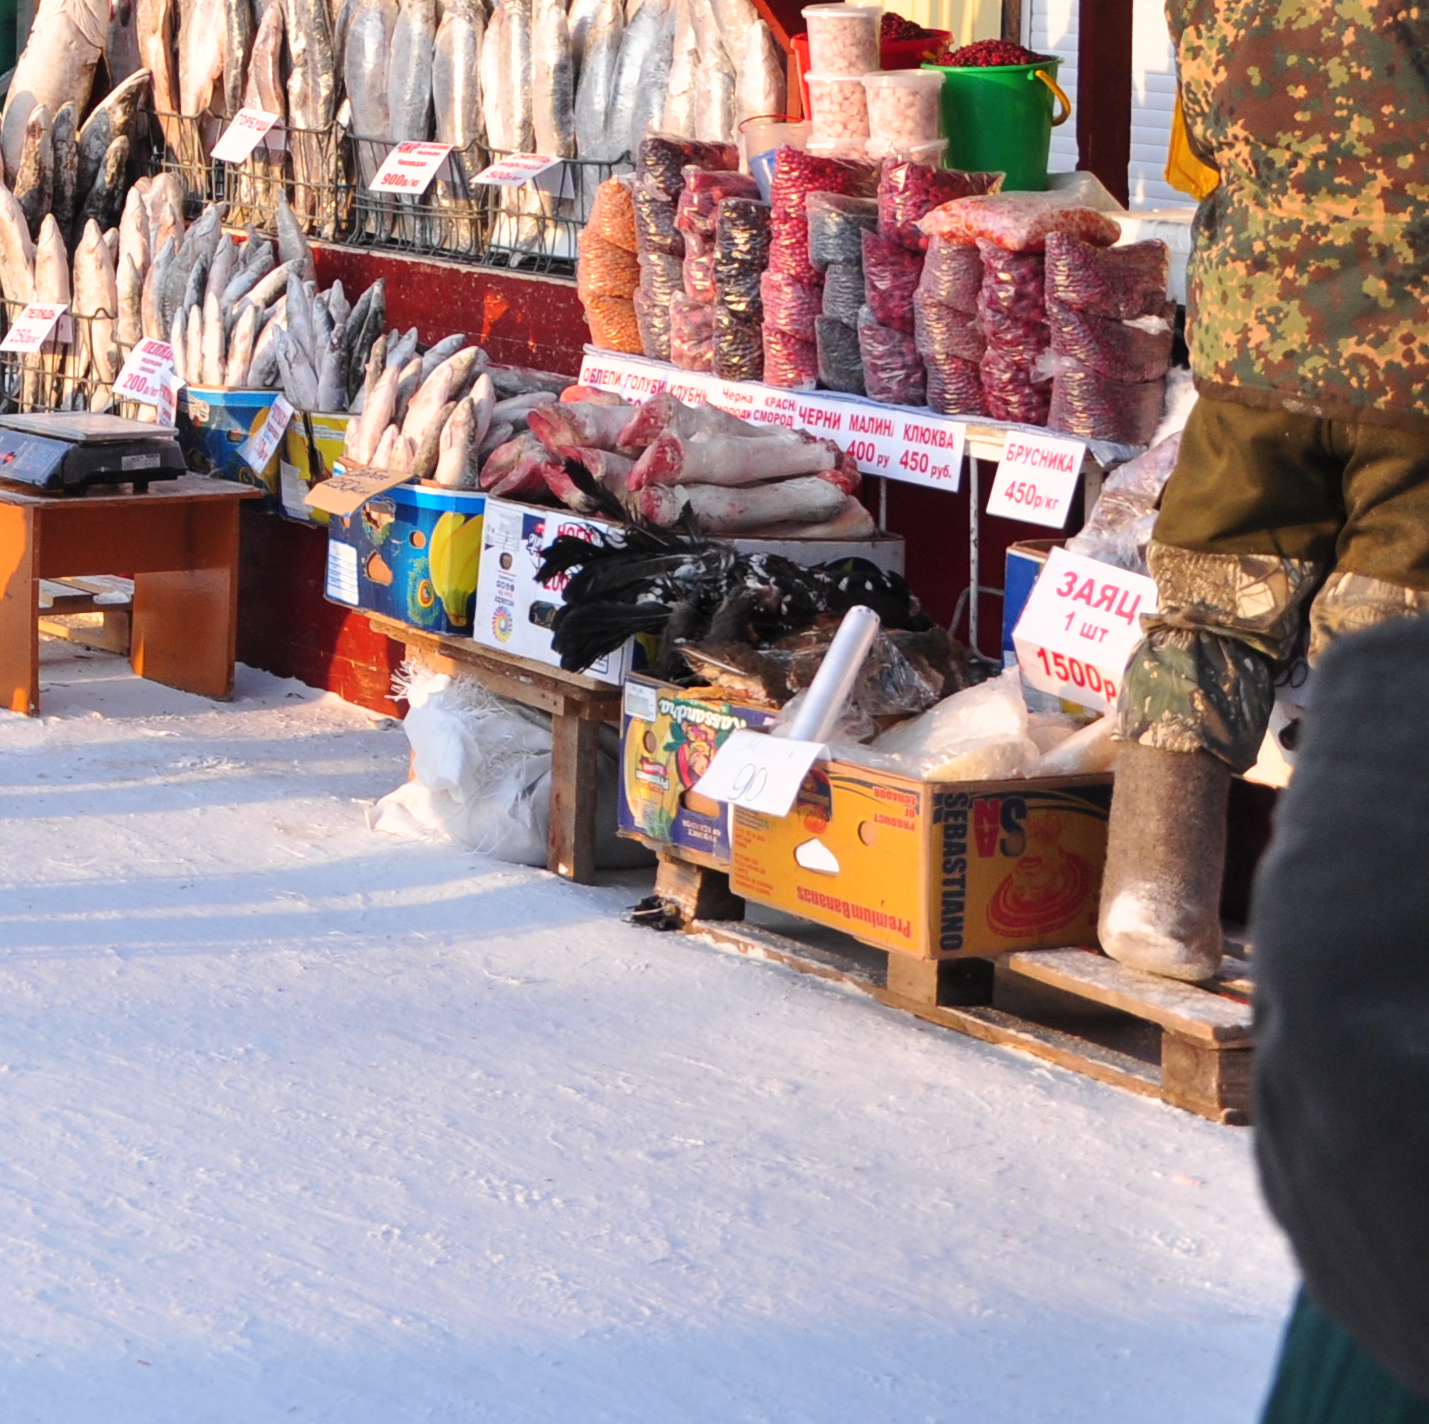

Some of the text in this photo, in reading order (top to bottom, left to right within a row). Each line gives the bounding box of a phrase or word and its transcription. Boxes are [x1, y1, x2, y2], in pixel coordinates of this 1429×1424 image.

[140, 340, 174, 362] ПЕЛЯД
[583, 367, 622, 385] ОБЛЕПИ
[764, 396, 796, 412] КРАСН
[753, 409, 794, 429] СМОРОД
[799, 405, 841, 430] ЧЕРНИ
[848, 413, 894, 437] МАЛИН
[903, 423, 954, 450] КЛЮКВА
[846, 439, 875, 463] 400
[1005, 443, 1075, 474] БРУСНИКА
[899, 449, 952, 481] 450 руб.
[1004, 480, 1060, 511] 450р/кг
[1055, 570, 1141, 626] ЗАЯЦ
[1064, 611, 1076, 632] 1
[1036, 646, 1117, 702] 1500р
[873, 787, 917, 807] ECUADOR
[873, 813, 917, 832] PRODUCT
[904, 808, 916, 818] OF
[940, 792, 970, 951] SEBASTIANO
